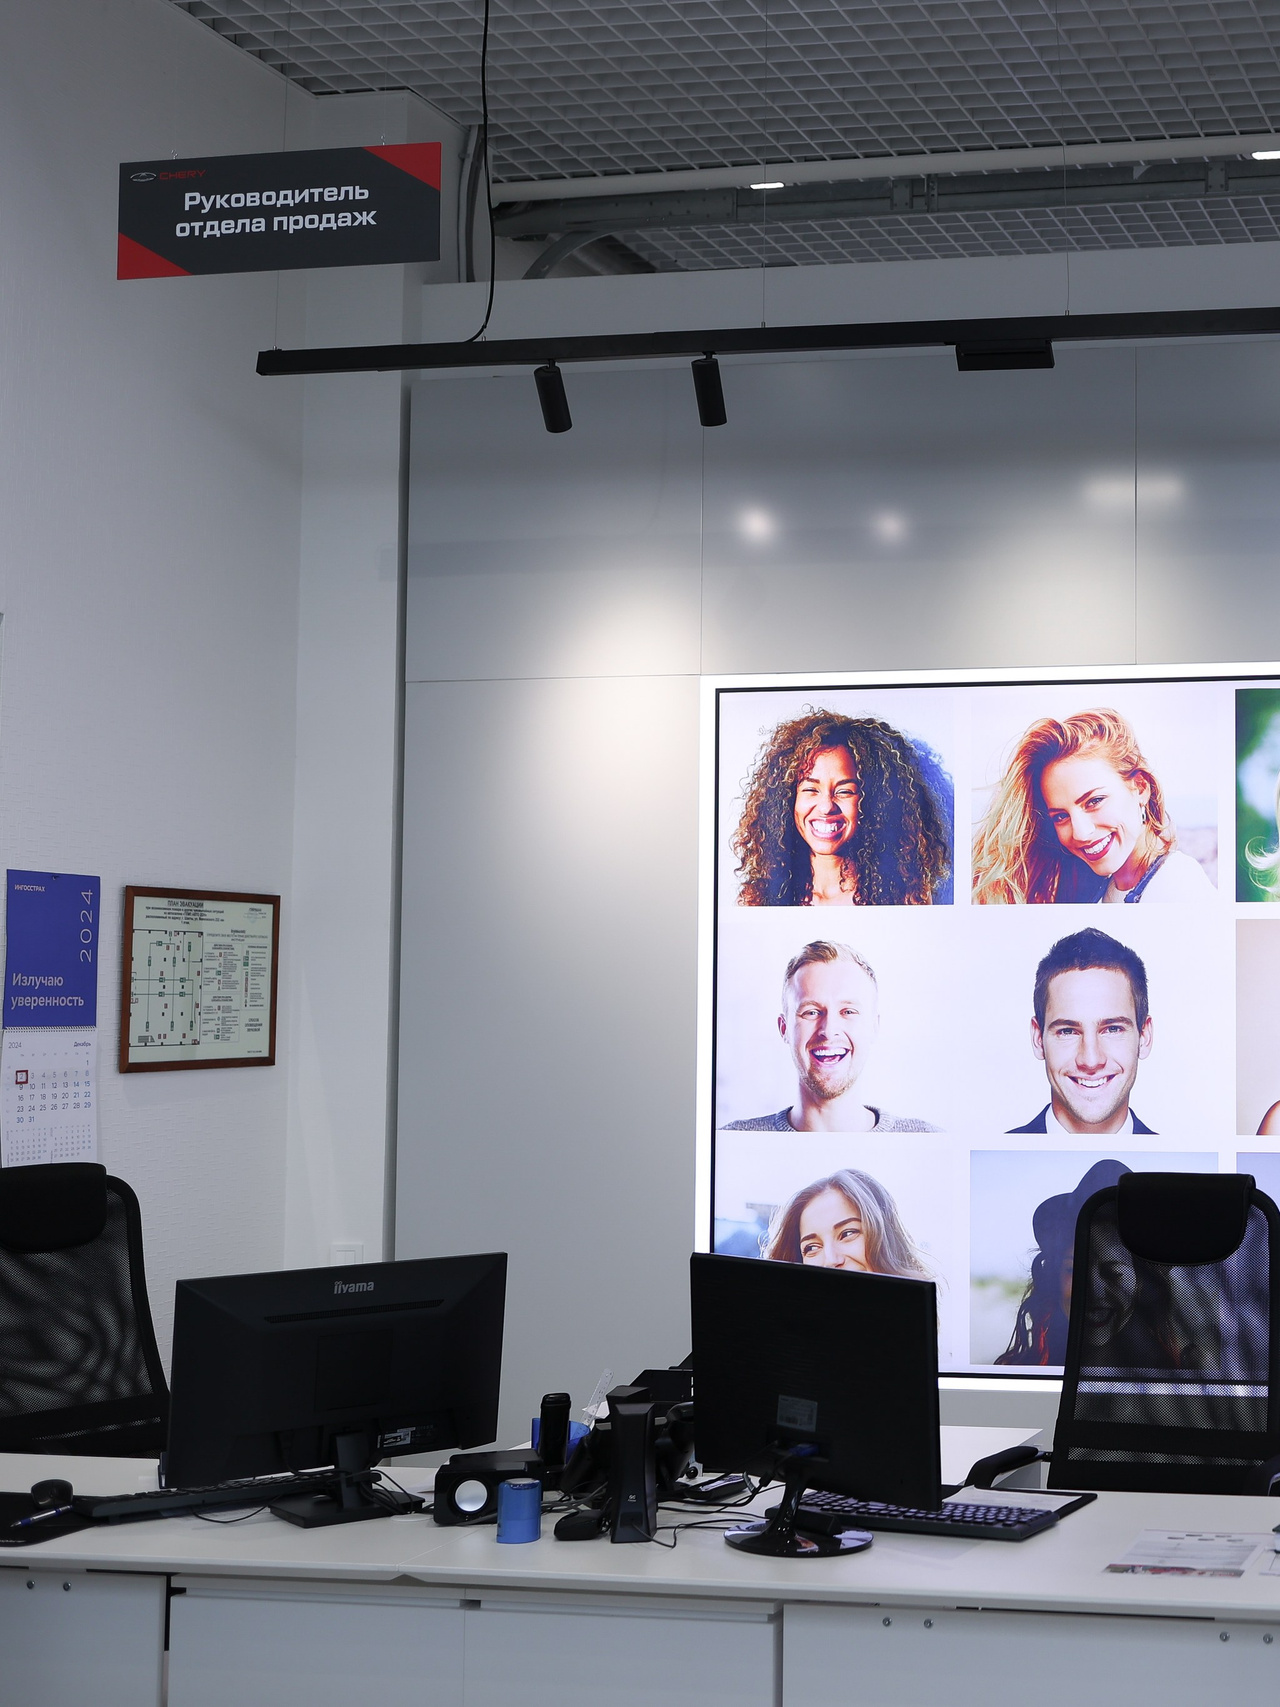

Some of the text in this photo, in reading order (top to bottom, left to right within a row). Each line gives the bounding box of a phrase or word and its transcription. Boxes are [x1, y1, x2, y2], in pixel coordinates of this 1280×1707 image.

[159, 170, 207, 181] CHERY
[184, 185, 370, 214] Руководитель
[175, 210, 378, 239] отдела продаж
[14, 884, 46, 892] ИНГОССТРАХ
[80, 889, 94, 963] 2024
[12, 972, 64, 988] Излучаю
[10, 993, 84, 1010] уверенность
[334, 1280, 374, 1294] iiyama
